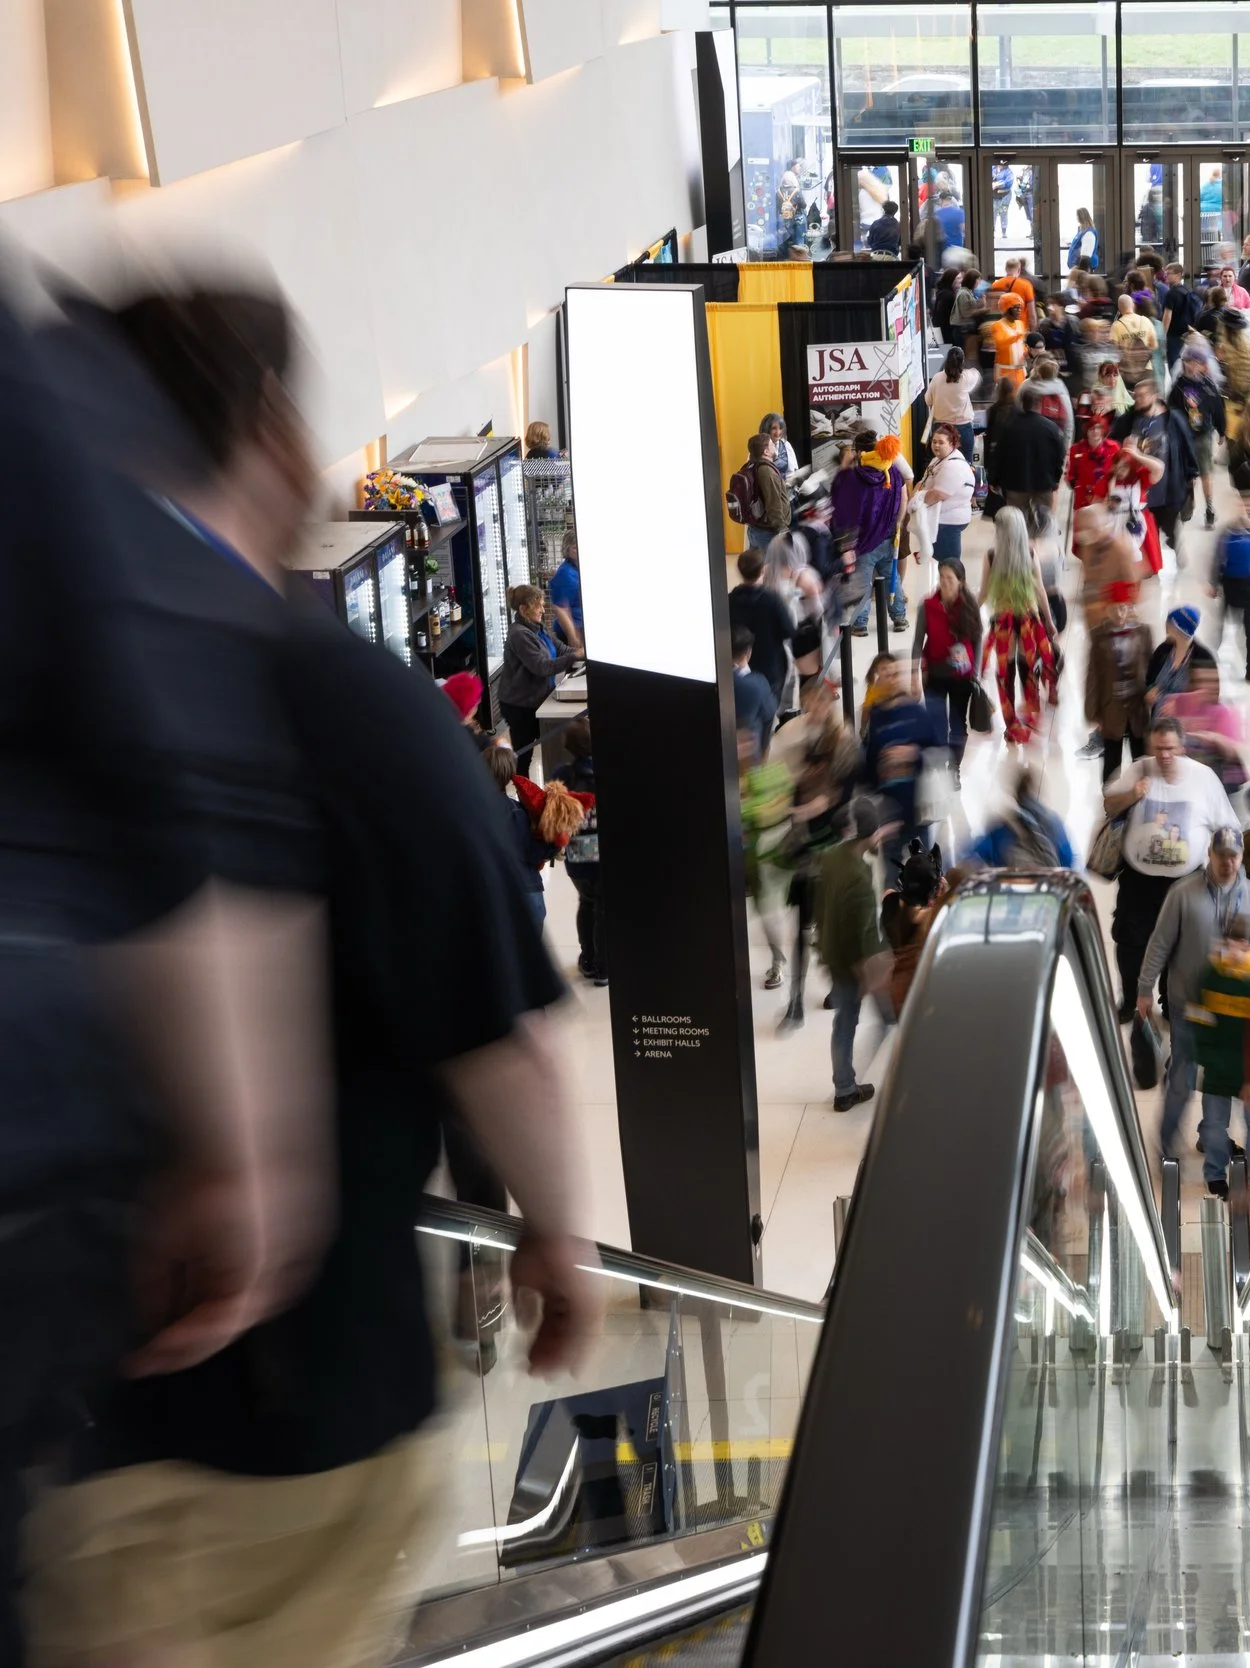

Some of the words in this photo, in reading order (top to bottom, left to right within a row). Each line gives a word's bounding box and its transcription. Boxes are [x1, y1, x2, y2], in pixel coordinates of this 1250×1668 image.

[914, 139, 930, 152] EXIT
[812, 347, 868, 381] JSA
[813, 385, 860, 393] AUTOGRAPH
[813, 392, 880, 401] AUTHENTICATION
[650, 1407, 660, 1433] RECYCLE
